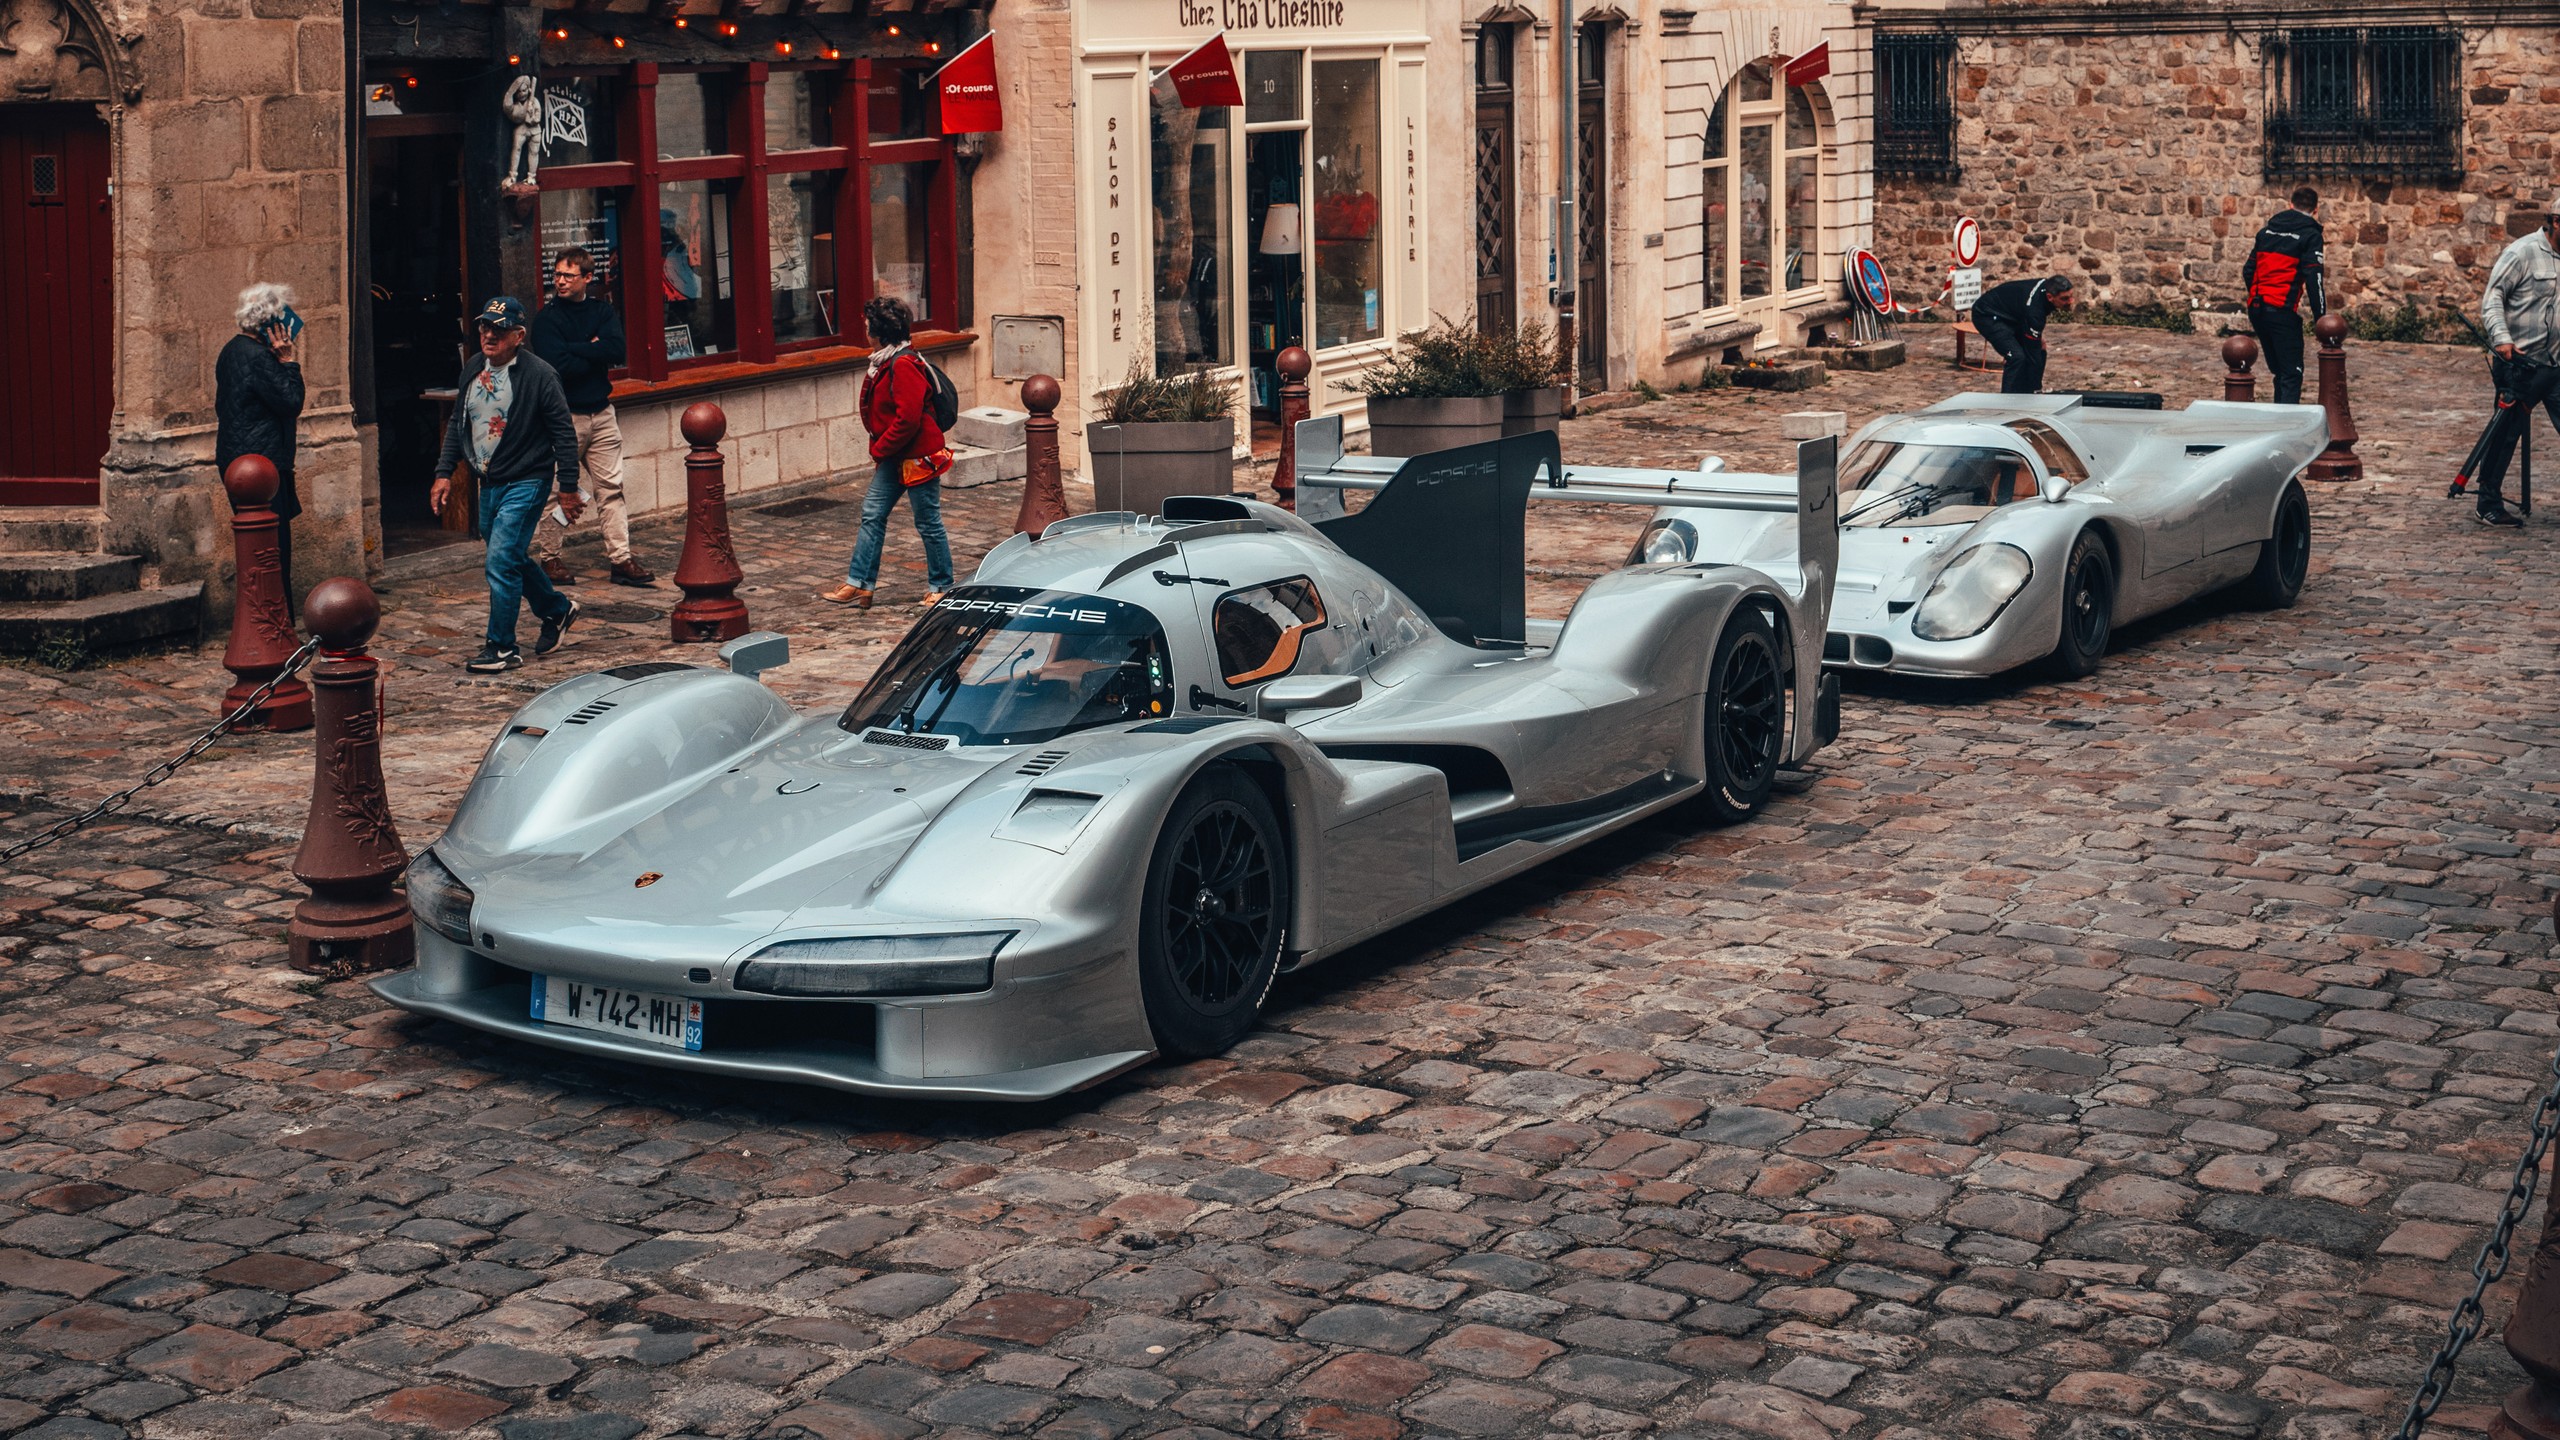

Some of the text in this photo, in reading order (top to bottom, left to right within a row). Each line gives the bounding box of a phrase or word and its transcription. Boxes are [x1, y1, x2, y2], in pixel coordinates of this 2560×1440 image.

[1180, 0, 1214, 27] Chez
[1196, 70, 1230, 79] course
[550, 85, 582, 103] atelier
[962, 84, 994, 93] course
[1263, 79, 1275, 94] 10
[947, 92, 995, 104] LE MANS
[1407, 116, 1416, 262] LIBRAIRIE
[1107, 117, 1121, 342] SALON DE THÉ
[1416, 461, 1497, 486] PORSCHE
[934, 598, 1107, 624] PORSCHE
[535, 999, 541, 1009] F
[686, 1026, 701, 1045] 92
